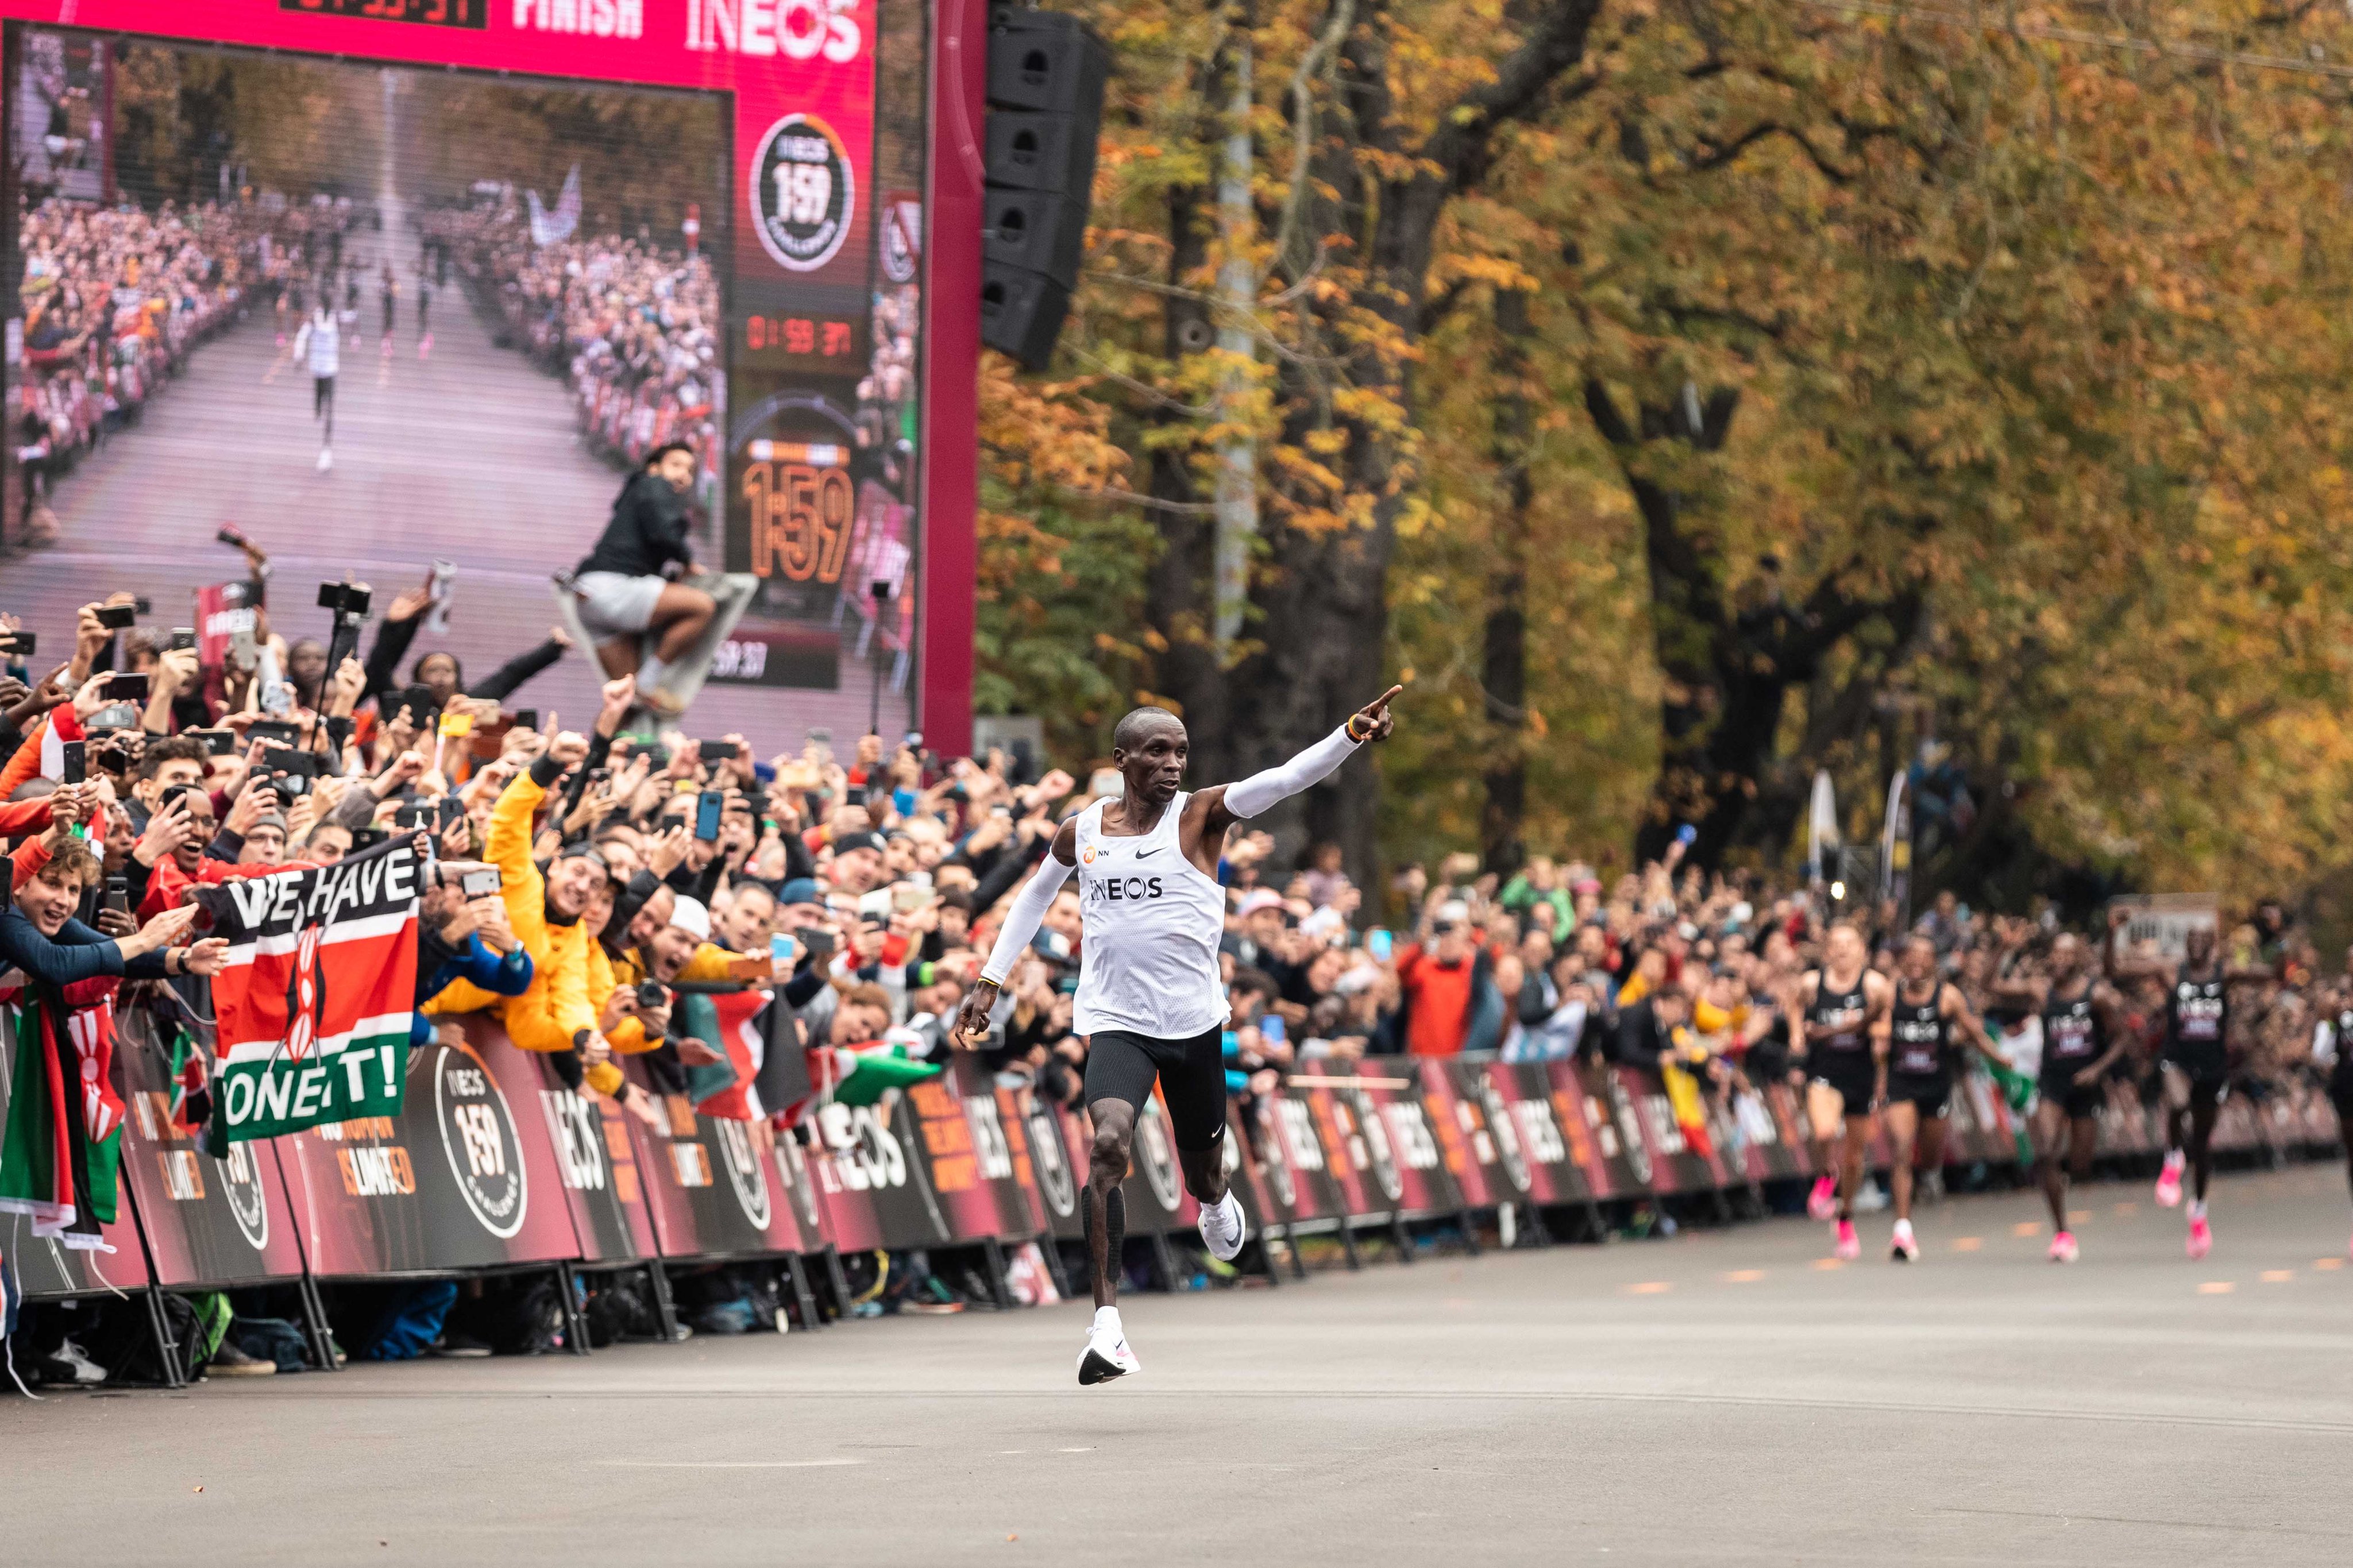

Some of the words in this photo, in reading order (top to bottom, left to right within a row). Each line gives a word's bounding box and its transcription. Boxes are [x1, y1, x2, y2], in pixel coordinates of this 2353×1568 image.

[684, 0, 861, 62] INEOS
[227, 870, 304, 929] WE
[307, 847, 415, 925] HAVE
[1090, 876, 1163, 901] INEOS
[223, 1066, 326, 1126] ONE
